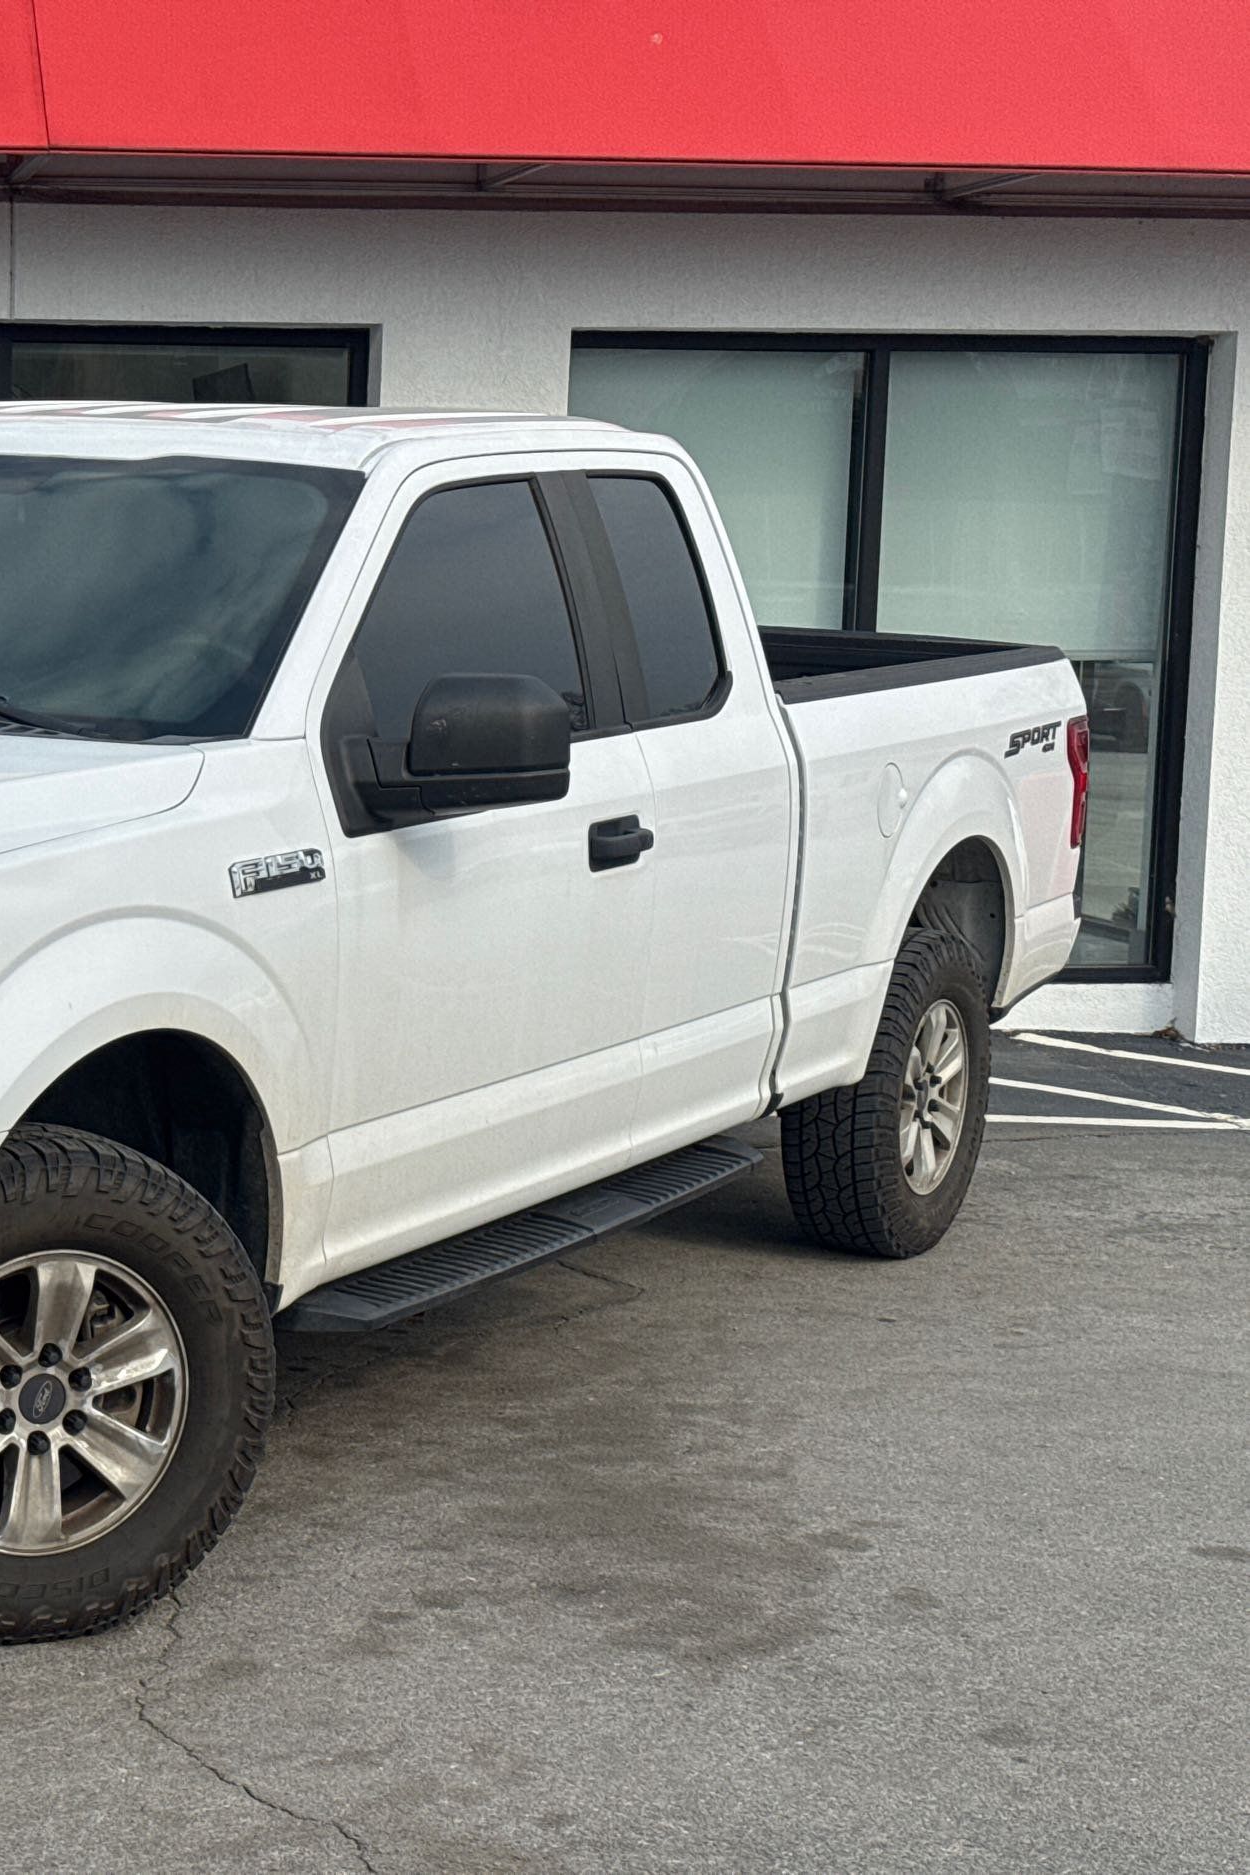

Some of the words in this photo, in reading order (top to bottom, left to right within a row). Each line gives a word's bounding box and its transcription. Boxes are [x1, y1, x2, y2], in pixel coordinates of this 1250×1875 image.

[1004, 720, 1062, 759] SPORT
[309, 871, 323, 880] XL
[83, 1213, 223, 1324] COOPER
